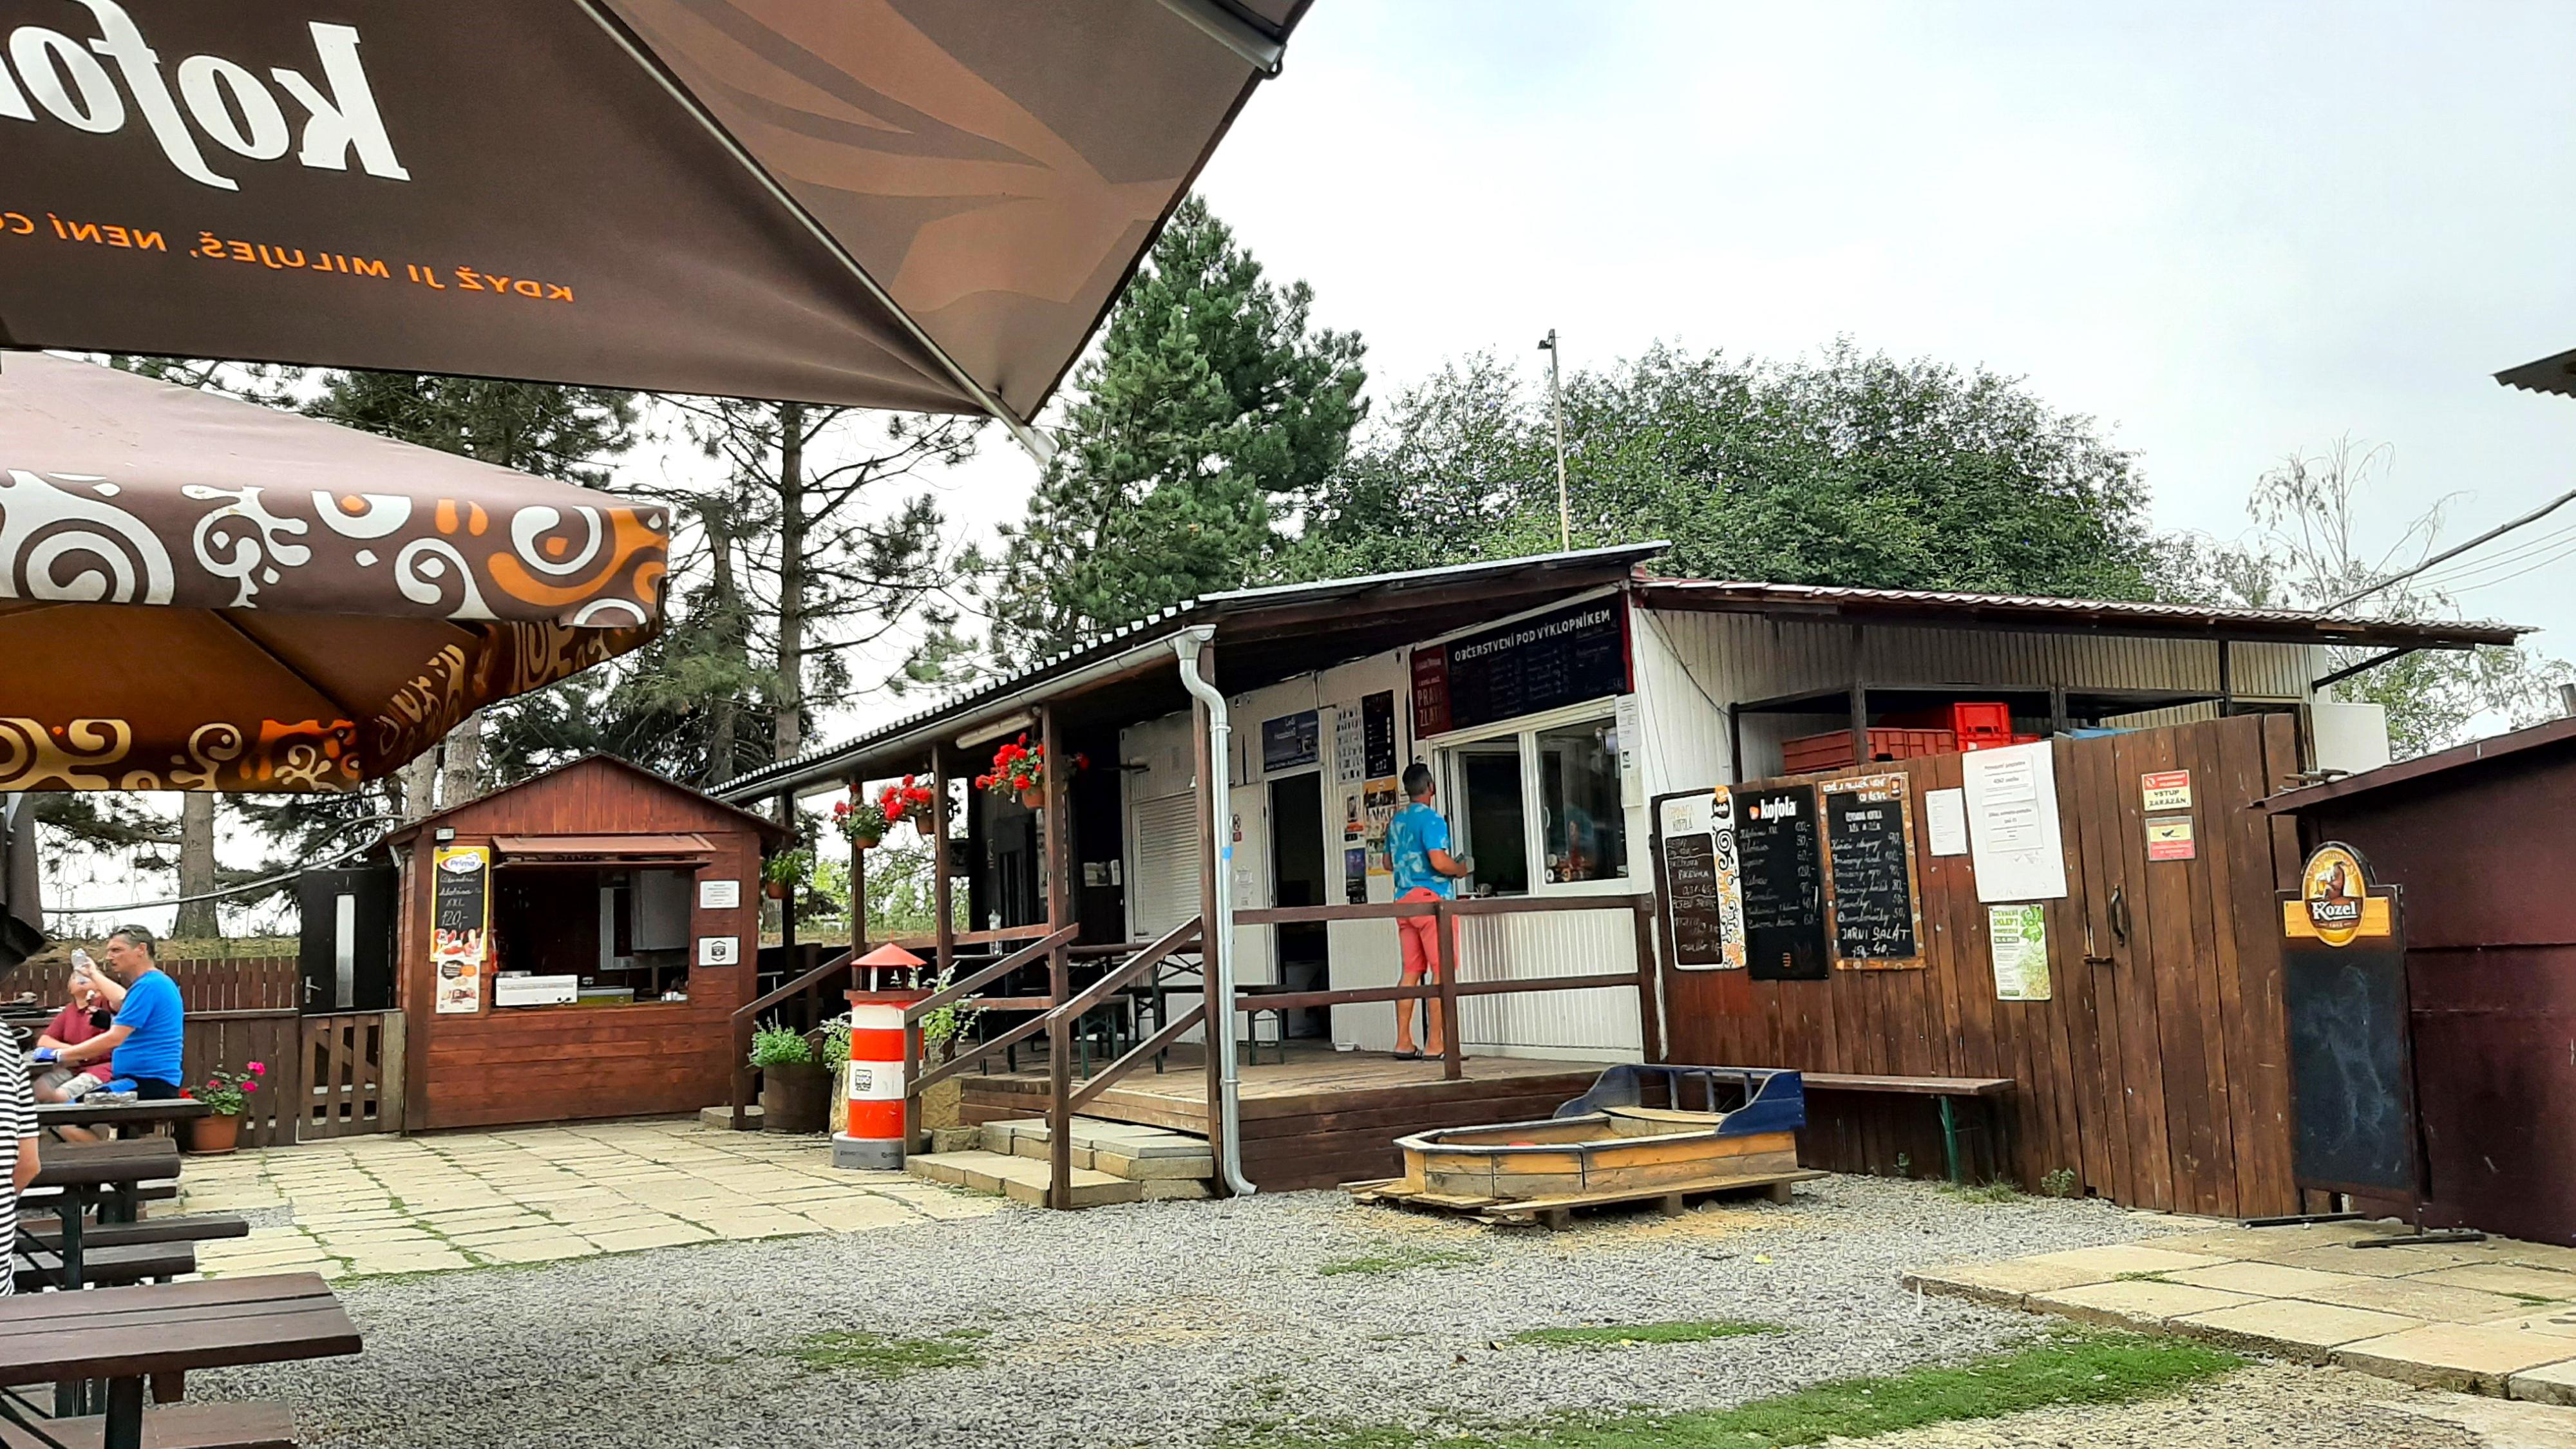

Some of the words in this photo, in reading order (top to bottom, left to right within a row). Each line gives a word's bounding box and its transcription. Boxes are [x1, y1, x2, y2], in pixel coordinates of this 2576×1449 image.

[1516, 630, 1535, 645] POD
[1537, 609, 1610, 639] VÝKLOPNÍKEM
[1760, 795, 1797, 824] kofola
[2311, 901, 2358, 921] Kozel
